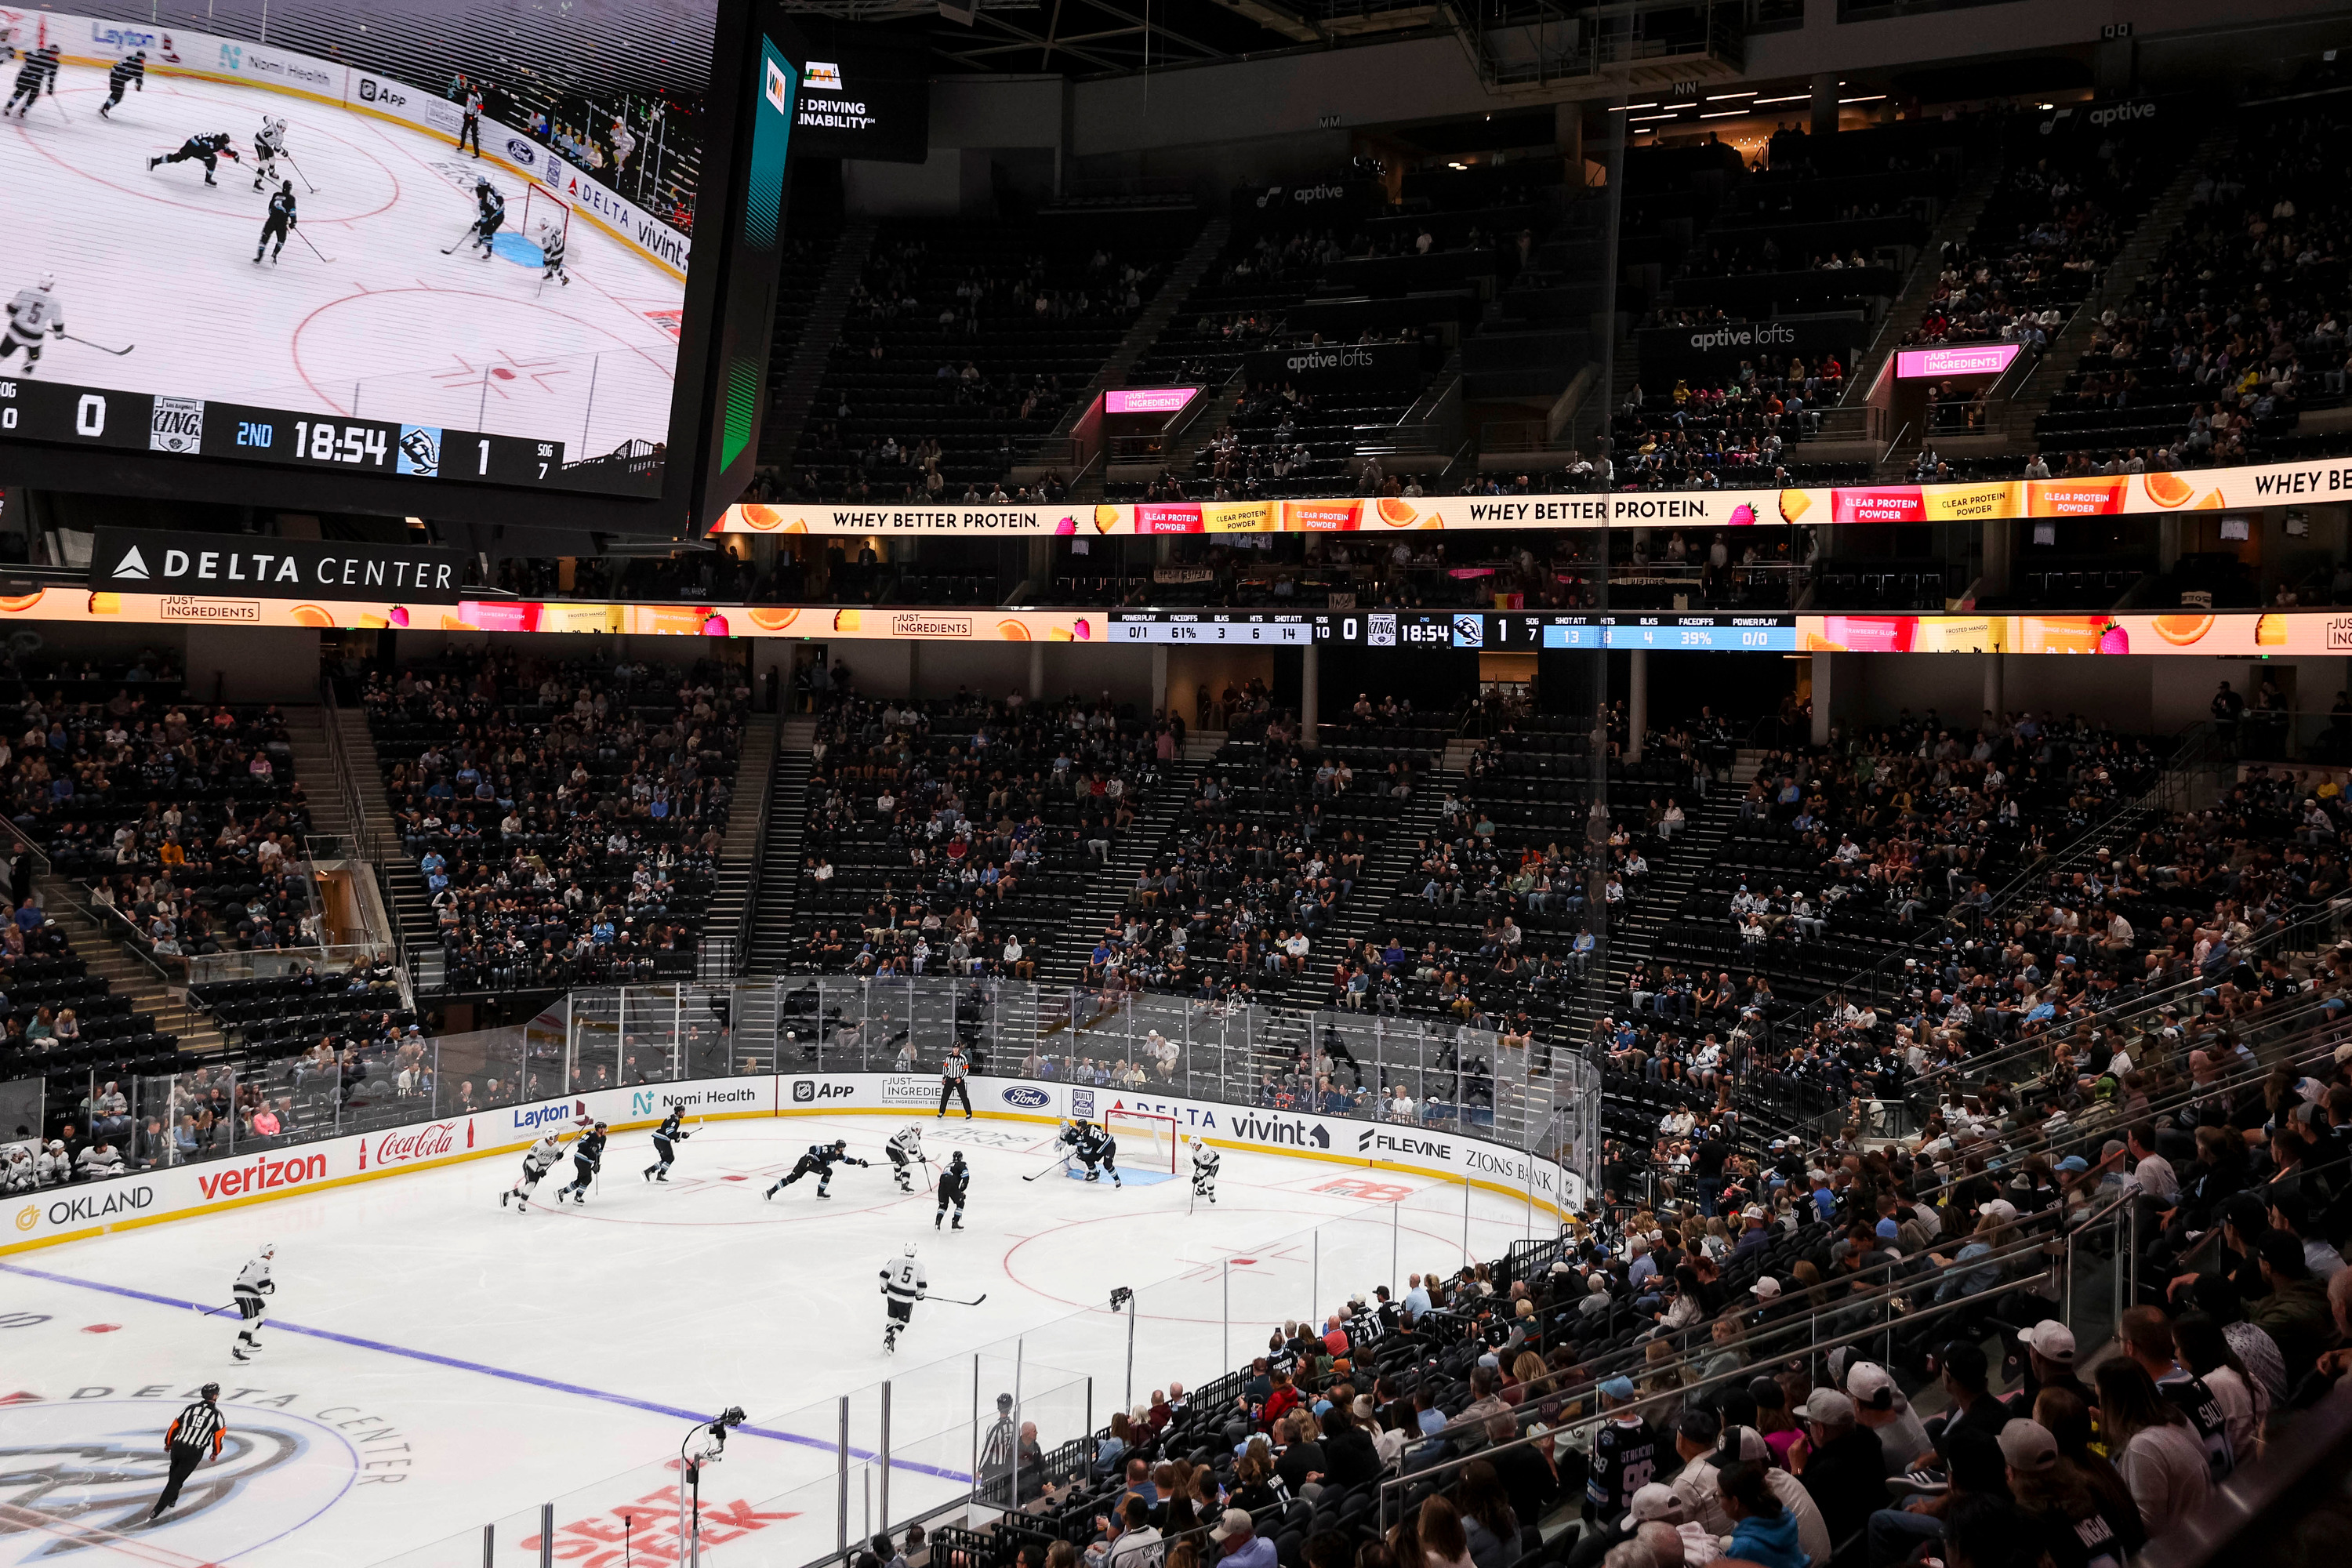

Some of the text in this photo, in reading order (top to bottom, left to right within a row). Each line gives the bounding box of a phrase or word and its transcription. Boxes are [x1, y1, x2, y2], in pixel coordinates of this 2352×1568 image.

[769, 71, 783, 103] WM
[1675, 82, 1696, 95] NN
[808, 100, 866, 114] DRIVING
[2089, 101, 2156, 128] aptive
[1319, 116, 1341, 129] MM
[1294, 183, 1344, 204] aptive
[583, 184, 629, 227] DELTA
[1690, 323, 1795, 351] aptive lofts
[1287, 347, 1373, 373] aptive lofts
[1929, 352, 1951, 361] JUST
[1929, 358, 1997, 370] INGREDIENTS
[1128, 398, 1180, 408] INGREDIENTS
[77, 394, 107, 437] 0
[237, 422, 273, 448] 2ND
[294, 421, 387, 465] 18:54
[478, 440, 491, 475] 1
[537, 443, 554, 458] SOG
[539, 463, 549, 480] 7
[2256, 471, 2322, 495] WHEY
[1845, 497, 1918, 510] CLEAR PROTEIN
[1942, 492, 2006, 510] CLEAR PROTEIN
[2044, 492, 2110, 504] CLEAR PROTEIN
[1469, 498, 1709, 521] WHEY BETTER PROTEIN.
[1858, 508, 1901, 521] POWDER
[1956, 503, 1993, 517] POWDER
[2056, 503, 2095, 513] POWDER
[833, 512, 1040, 528] WHEY BETTER PROTEIN.
[1144, 512, 1198, 522] CLEAR PROTEIN
[1216, 510, 1267, 523] CLEAR PROTEIN
[1296, 510, 1349, 522] CLEAR PROTEIN
[1154, 523, 1186, 532] POWDER
[1227, 519, 1256, 530] POWDER
[1306, 521, 1337, 530] POWDER
[164, 550, 452, 590] DELTA CENTER
[166, 596, 195, 605] JUST
[167, 605, 255, 619] INGREDIENTS
[896, 614, 919, 623] JUST
[898, 623, 969, 634] INGREDIENTS
[1129, 626, 1148, 639] 0/1
[1171, 627, 1196, 639] 61%
[1218, 627, 1225, 639] 3
[1252, 627, 1260, 639] 6
[1282, 627, 1296, 640] 14
[1316, 626, 1330, 638] 10
[1342, 619, 1357, 639] 0
[1402, 625, 1449, 641] 18:54
[1498, 619, 1506, 641] 1
[1528, 629, 1537, 641] 7
[1564, 631, 1579, 643] 13
[1644, 632, 1653, 644] 4
[1680, 632, 1711, 645] 39%
[1742, 633, 1767, 645] 0/0
[2286, 985, 2297, 994] 70
[663, 1088, 756, 1108] Nomi Health
[887, 1087, 961, 1098] INGREDIET
[1008, 1087, 1045, 1105] Ford
[514, 1105, 569, 1129] Layton
[1377, 1134, 1451, 1160] FILEVINE
[199, 1153, 326, 1200] verizon
[1466, 1149, 1513, 1177] ZIONS
[1517, 1163, 1552, 1192] BANK
[49, 1185, 153, 1225] OKLAND
[902, 1266, 913, 1283] 5
[1542, 1402, 1558, 1414] STOP
[191, 1414, 206, 1428] 19
[315, 1406, 412, 1487] CENTER
[520, 1485, 705, 1560] SEAT
